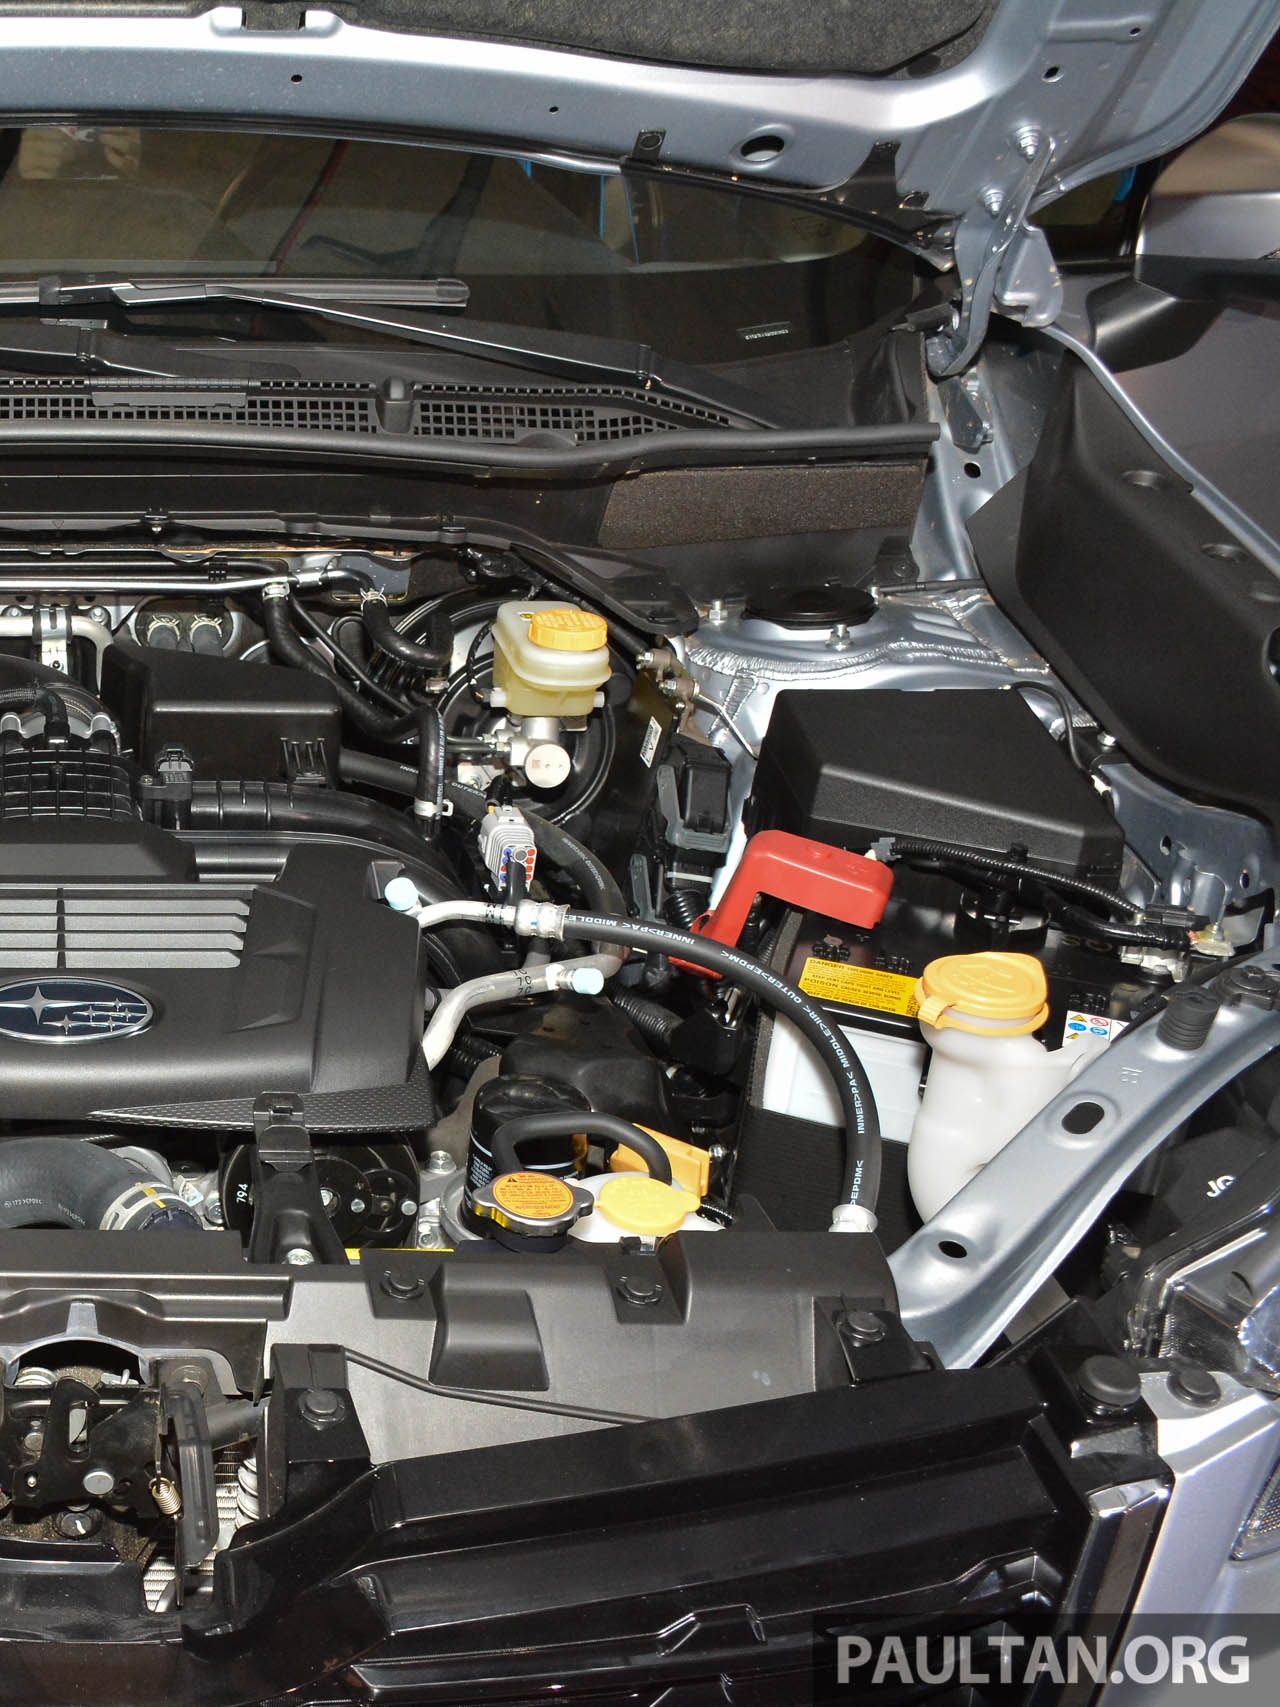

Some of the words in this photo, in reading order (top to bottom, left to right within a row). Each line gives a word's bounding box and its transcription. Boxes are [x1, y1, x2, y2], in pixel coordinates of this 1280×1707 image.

[622, 921, 695, 945] INNER>PA<
[809, 959, 845, 970] DANGER
[804, 977, 839, 988] POISON
[235, 1183, 249, 1204] 794
